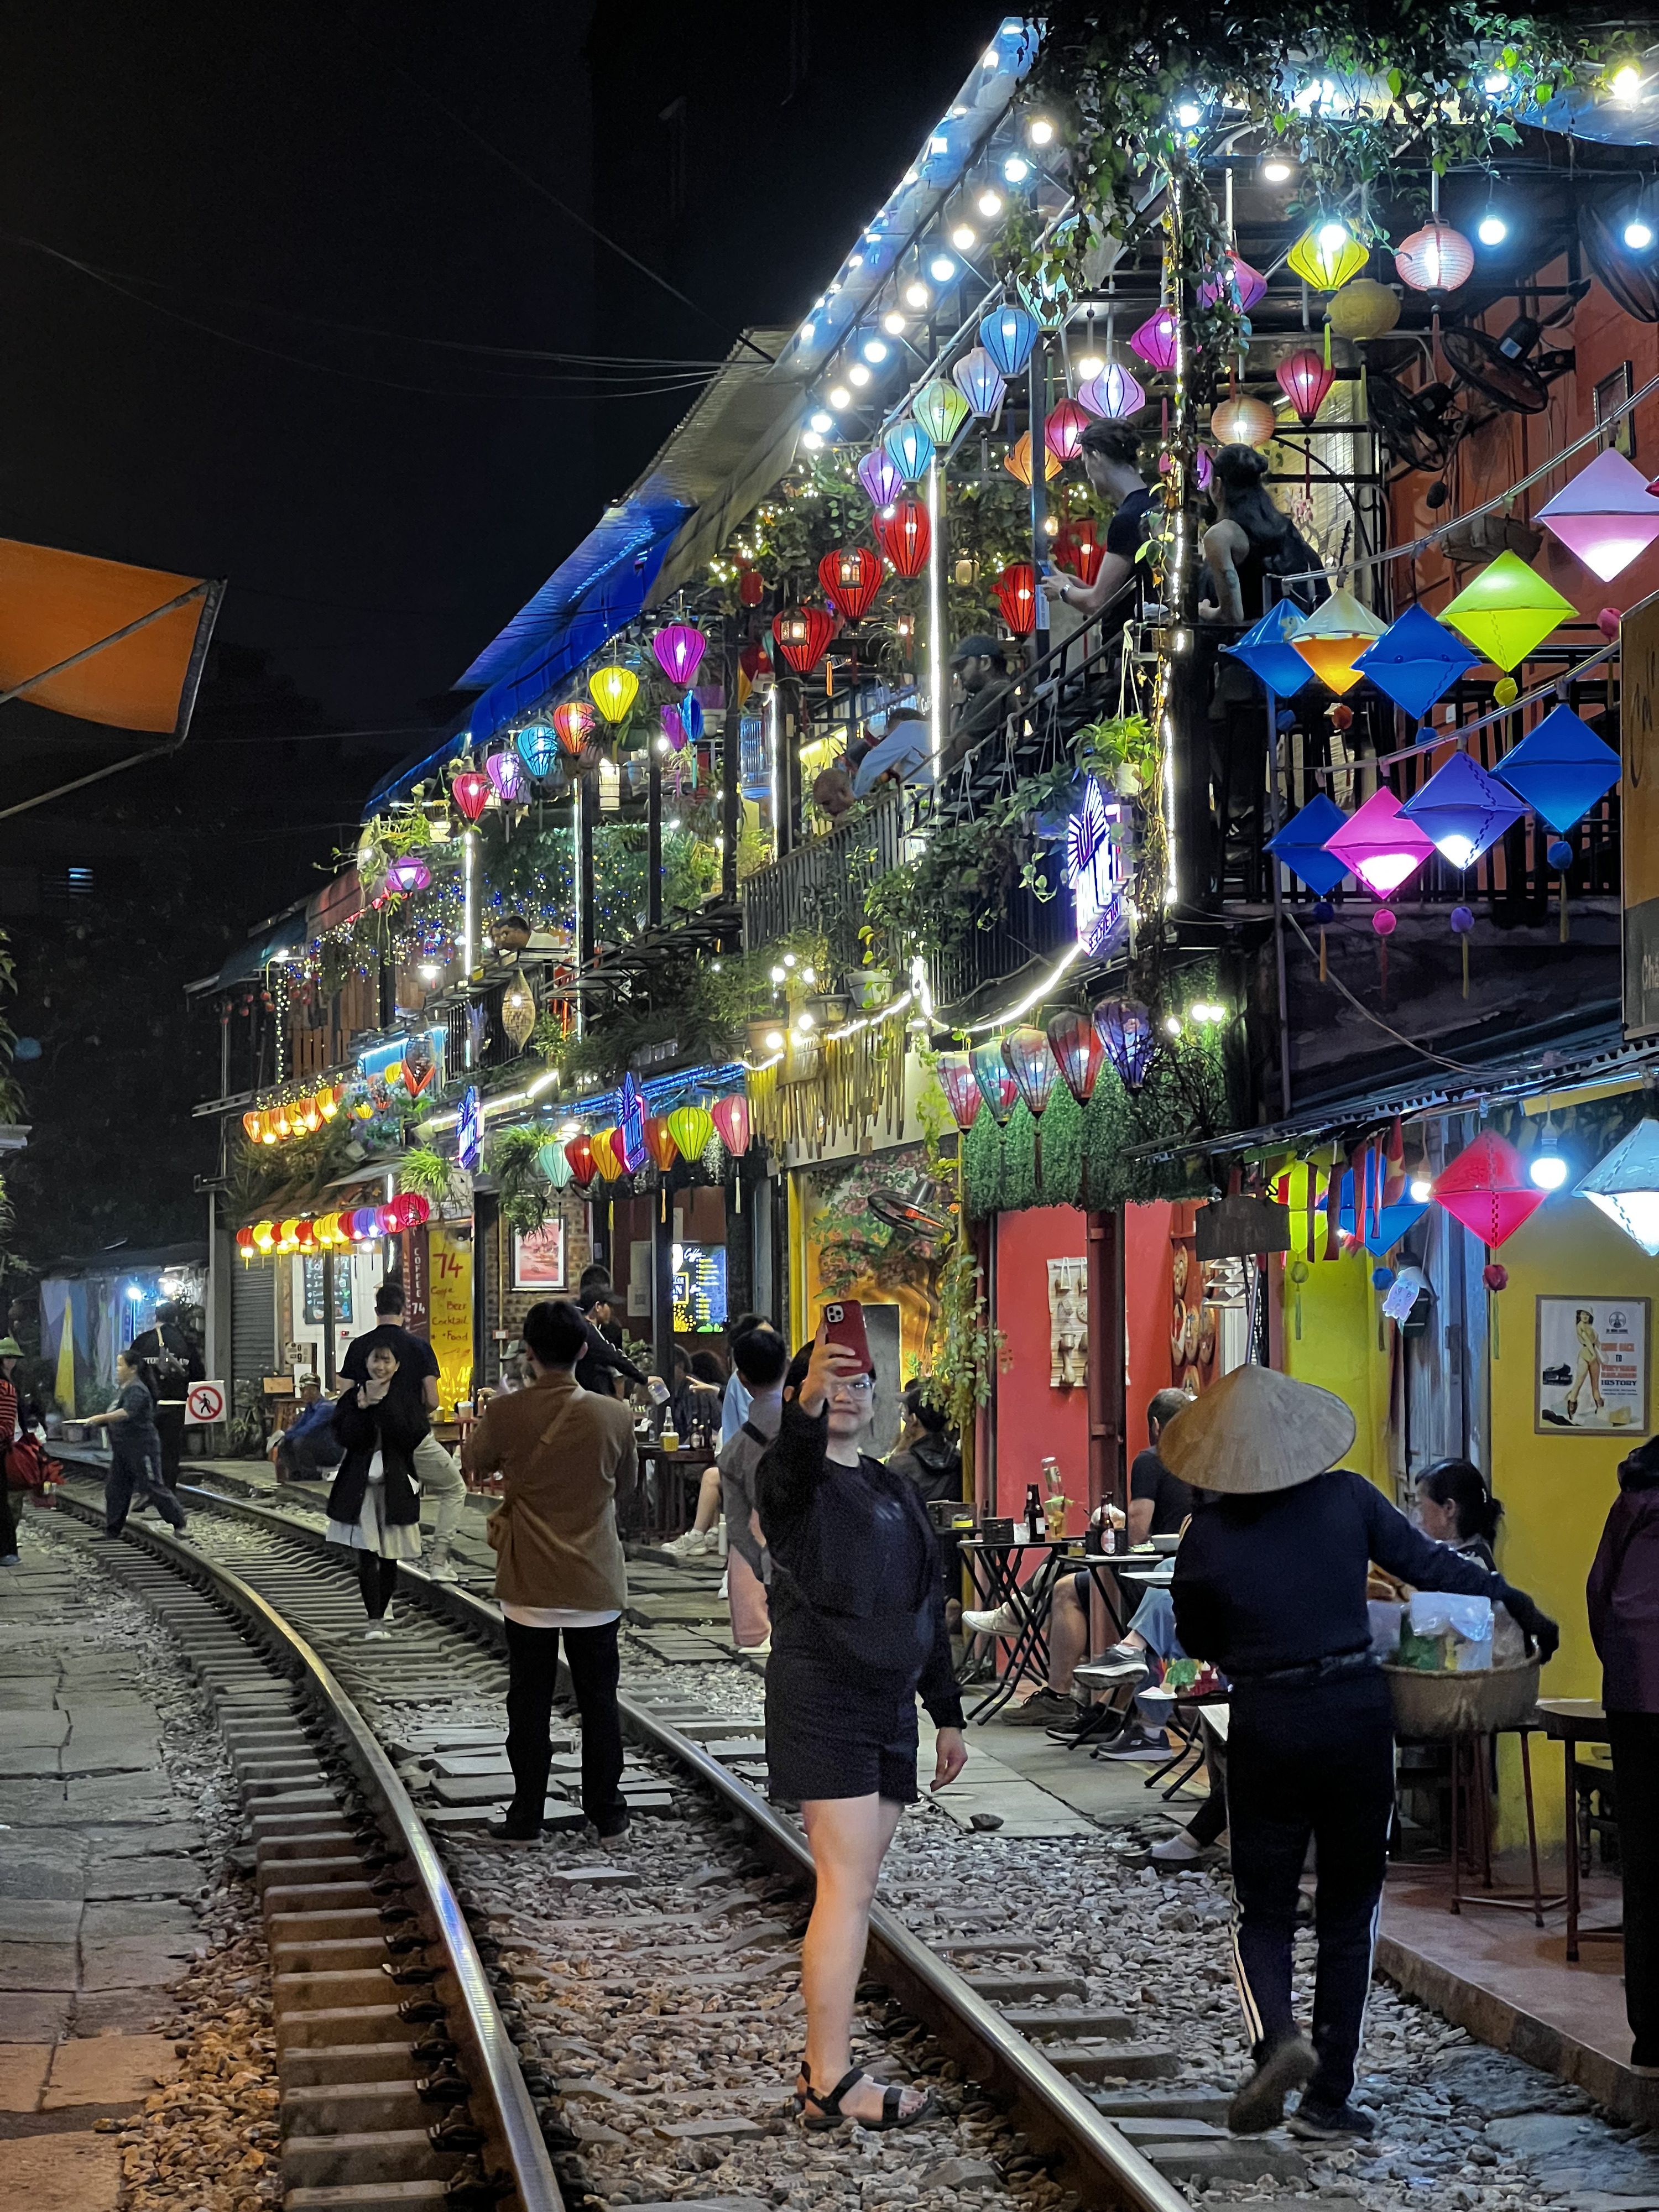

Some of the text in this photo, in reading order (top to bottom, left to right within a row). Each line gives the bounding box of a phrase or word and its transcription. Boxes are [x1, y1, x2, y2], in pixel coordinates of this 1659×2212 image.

[432, 1253, 463, 1279] 74
[411, 1302, 425, 1314] 74
[432, 1316, 468, 1326] Cocktail
[447, 1331, 468, 1341] Food
